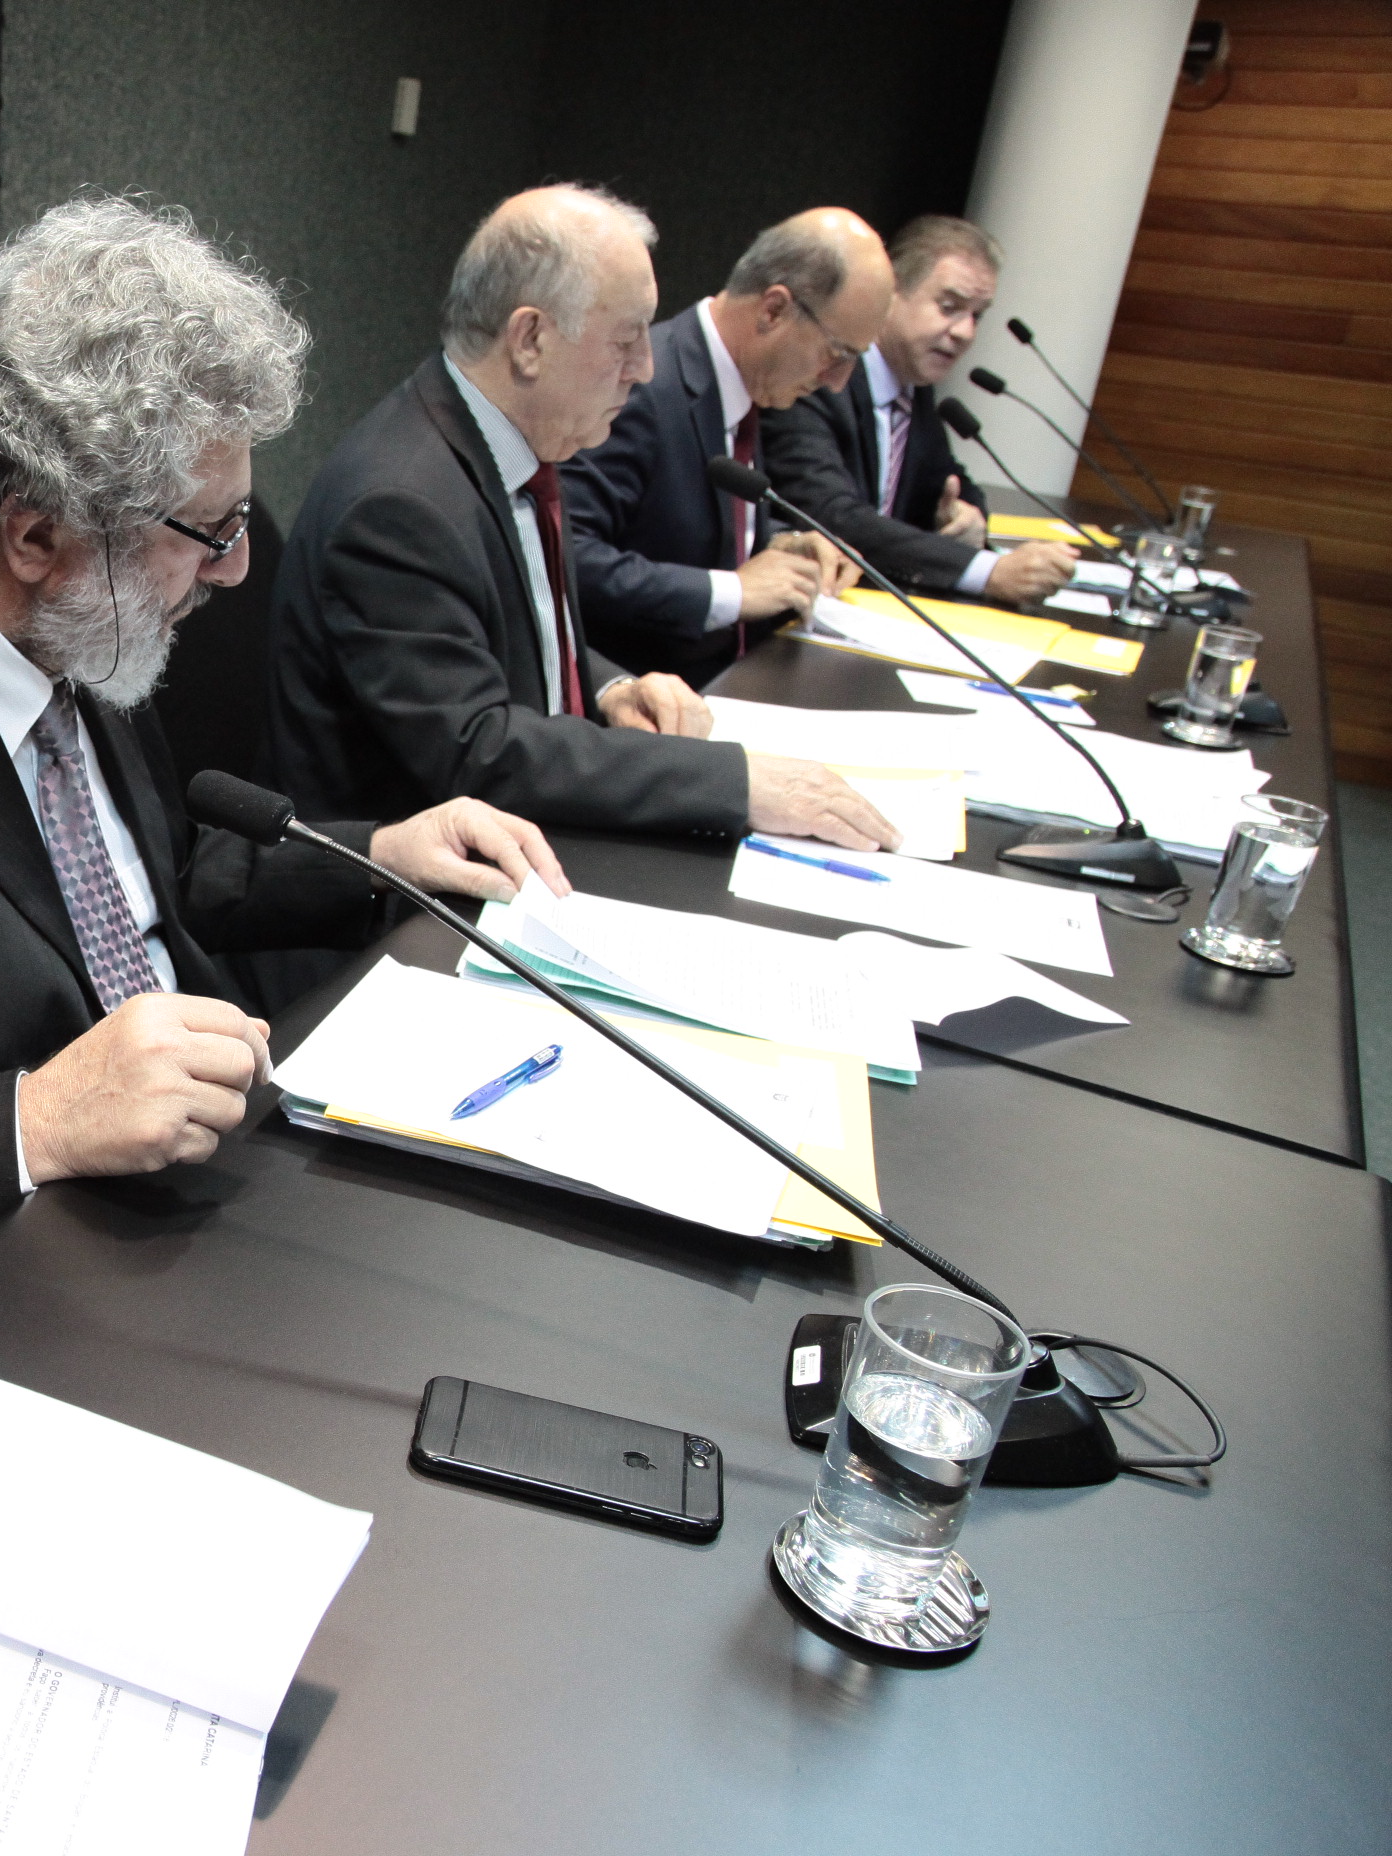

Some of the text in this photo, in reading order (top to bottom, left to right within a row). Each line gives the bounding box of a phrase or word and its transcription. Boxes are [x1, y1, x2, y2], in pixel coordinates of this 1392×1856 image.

[28, 1656, 42, 1681] decreta
[39, 1669, 51, 1684] Faço
[36, 1680, 59, 1733] GOVERNADOR
